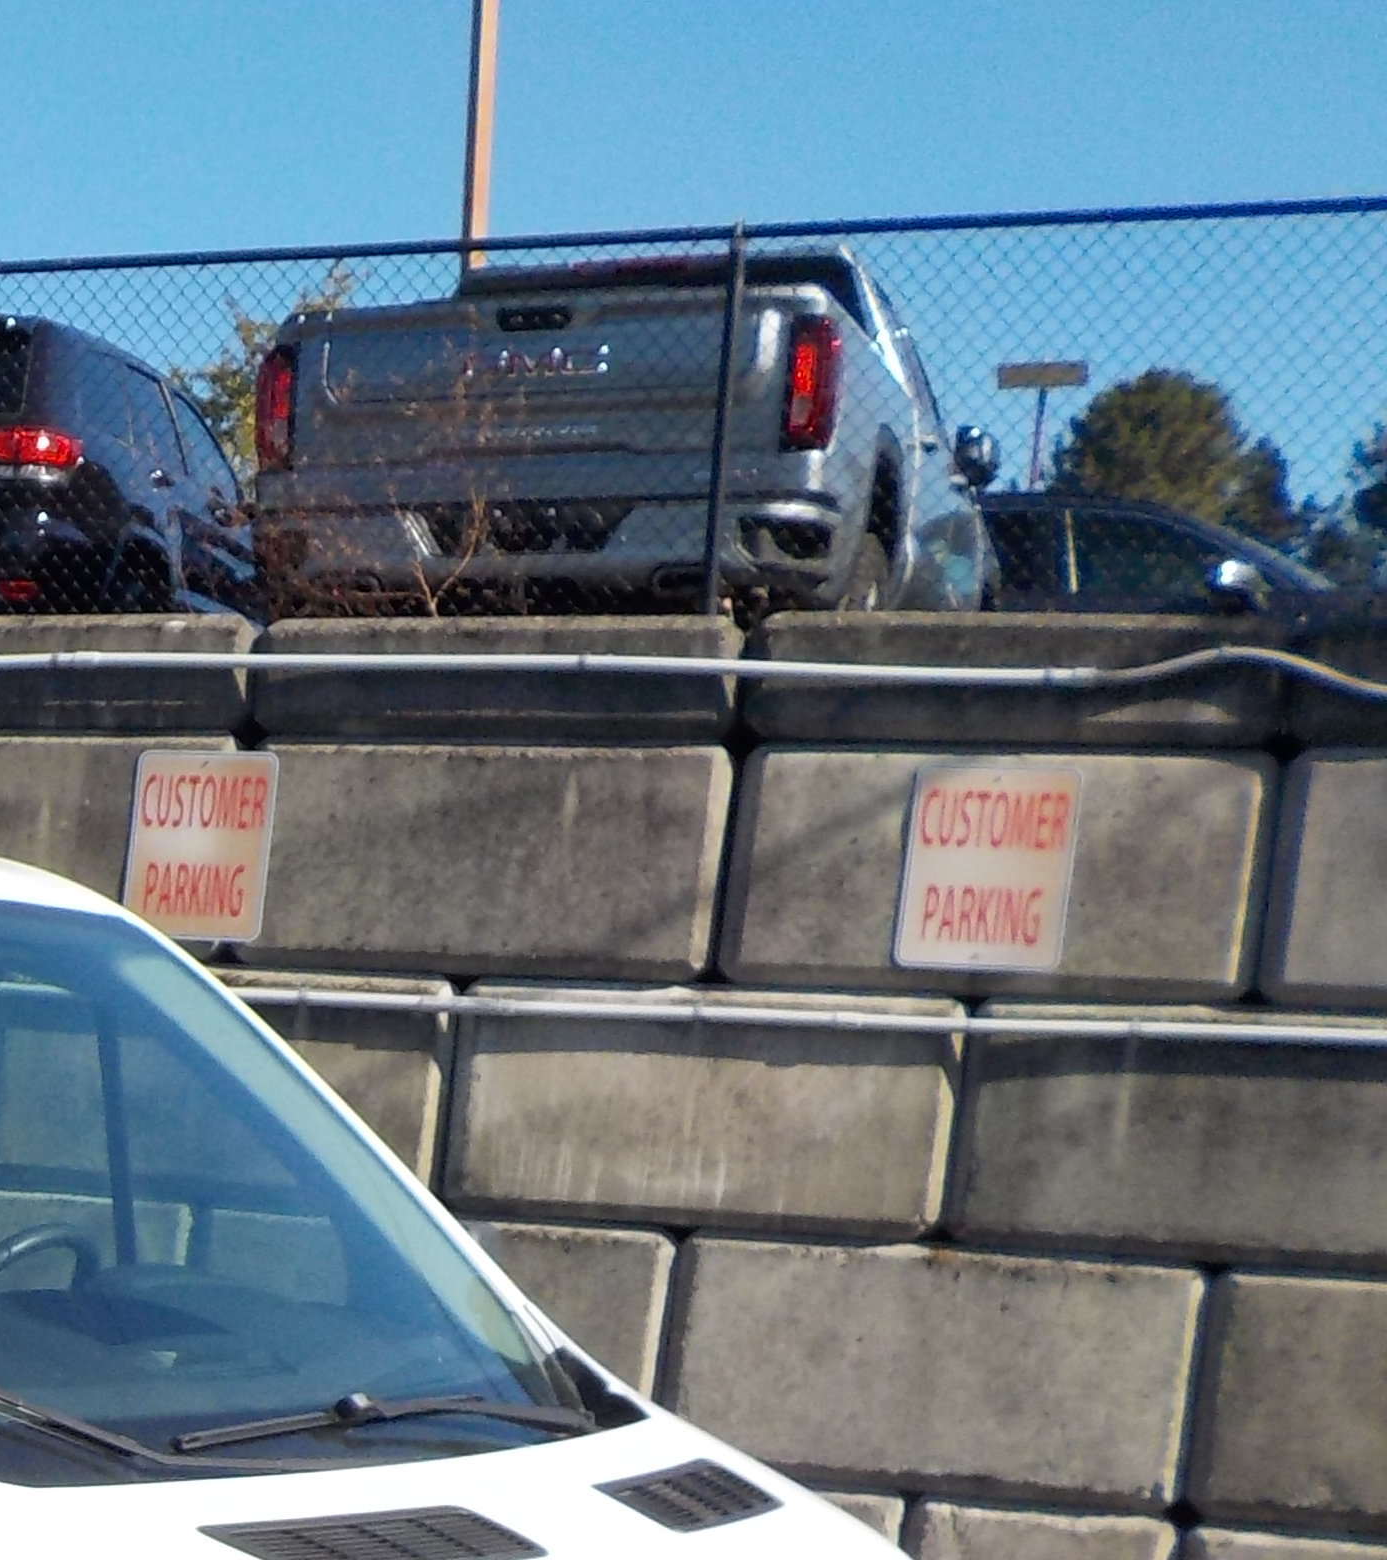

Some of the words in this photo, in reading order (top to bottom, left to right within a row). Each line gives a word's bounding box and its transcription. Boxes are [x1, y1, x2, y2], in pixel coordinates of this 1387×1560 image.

[142, 774, 268, 829] CUSTOMER
[921, 788, 1071, 849] CUSTOMER
[143, 862, 246, 917] PARKING
[921, 883, 1042, 945] PARKING
